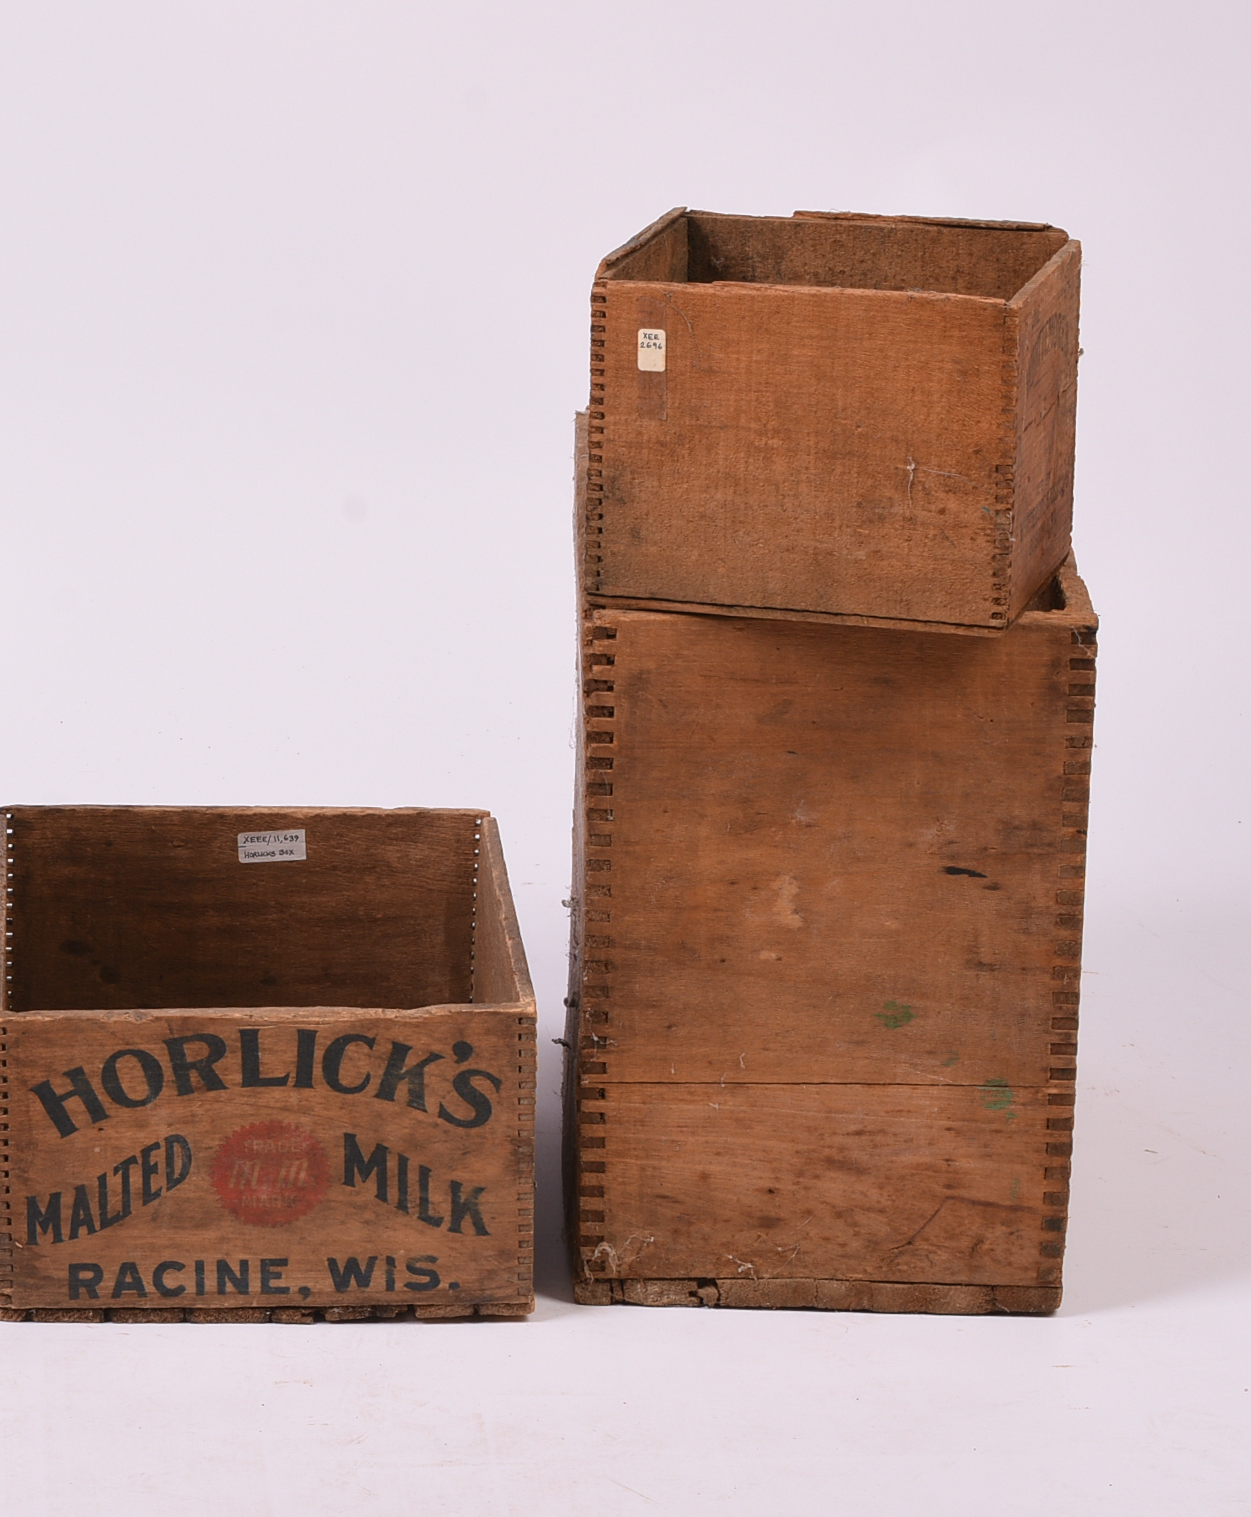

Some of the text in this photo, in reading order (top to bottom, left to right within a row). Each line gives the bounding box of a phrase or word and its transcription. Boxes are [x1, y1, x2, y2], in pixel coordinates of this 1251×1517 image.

[639, 341, 663, 350] 2696
[28, 1027, 503, 1139] HORLICK'S
[24, 1132, 194, 1247] MALTED
[341, 1131, 492, 1237] MILK
[67, 1256, 312, 1301] RACINE,
